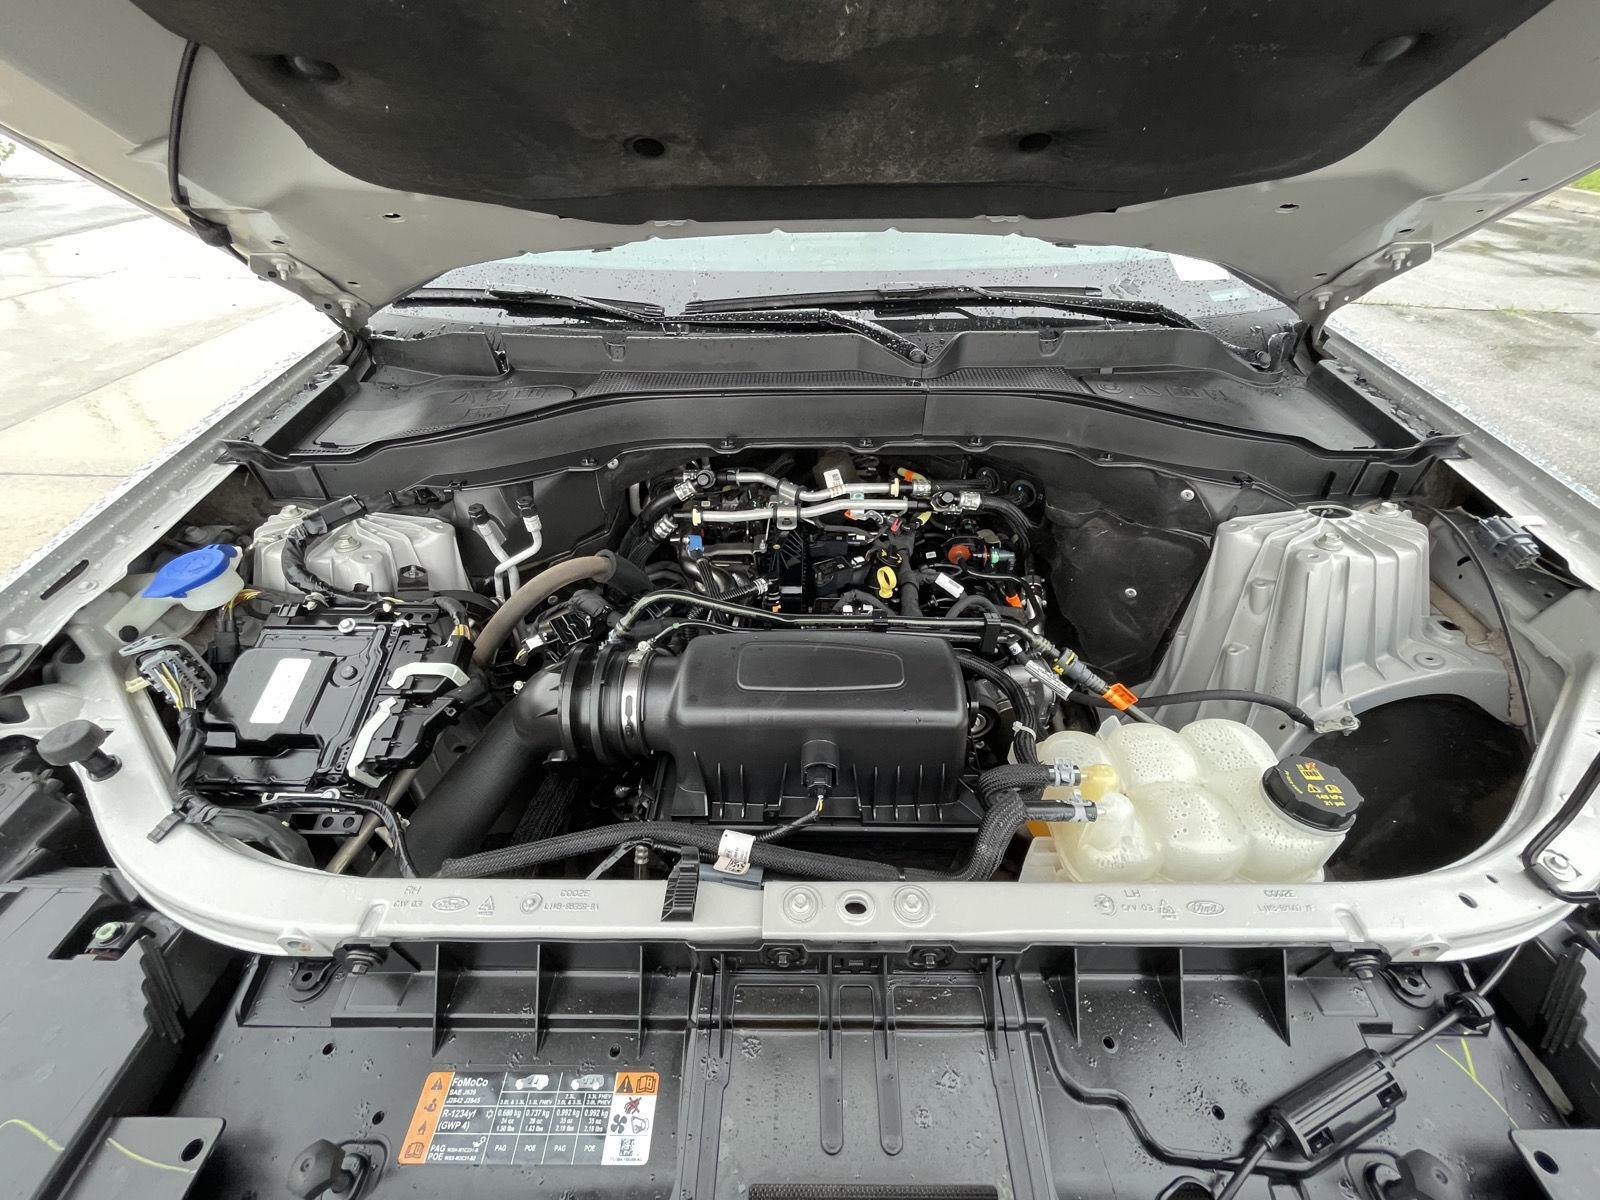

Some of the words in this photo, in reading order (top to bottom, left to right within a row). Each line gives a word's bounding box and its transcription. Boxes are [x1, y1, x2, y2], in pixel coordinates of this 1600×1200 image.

[1124, 889, 1141, 898] LH
[452, 1078, 488, 1087] FoMoCo
[442, 1109, 477, 1120] R-1234yf
[514, 1109, 522, 1118] kg
[542, 1109, 550, 1118] kg
[572, 1109, 580, 1118] kg
[600, 1109, 609, 1118] kg
[438, 1121, 461, 1132] (GWP
[462, 1121, 470, 1132] 4)
[430, 1144, 446, 1152] PAG
